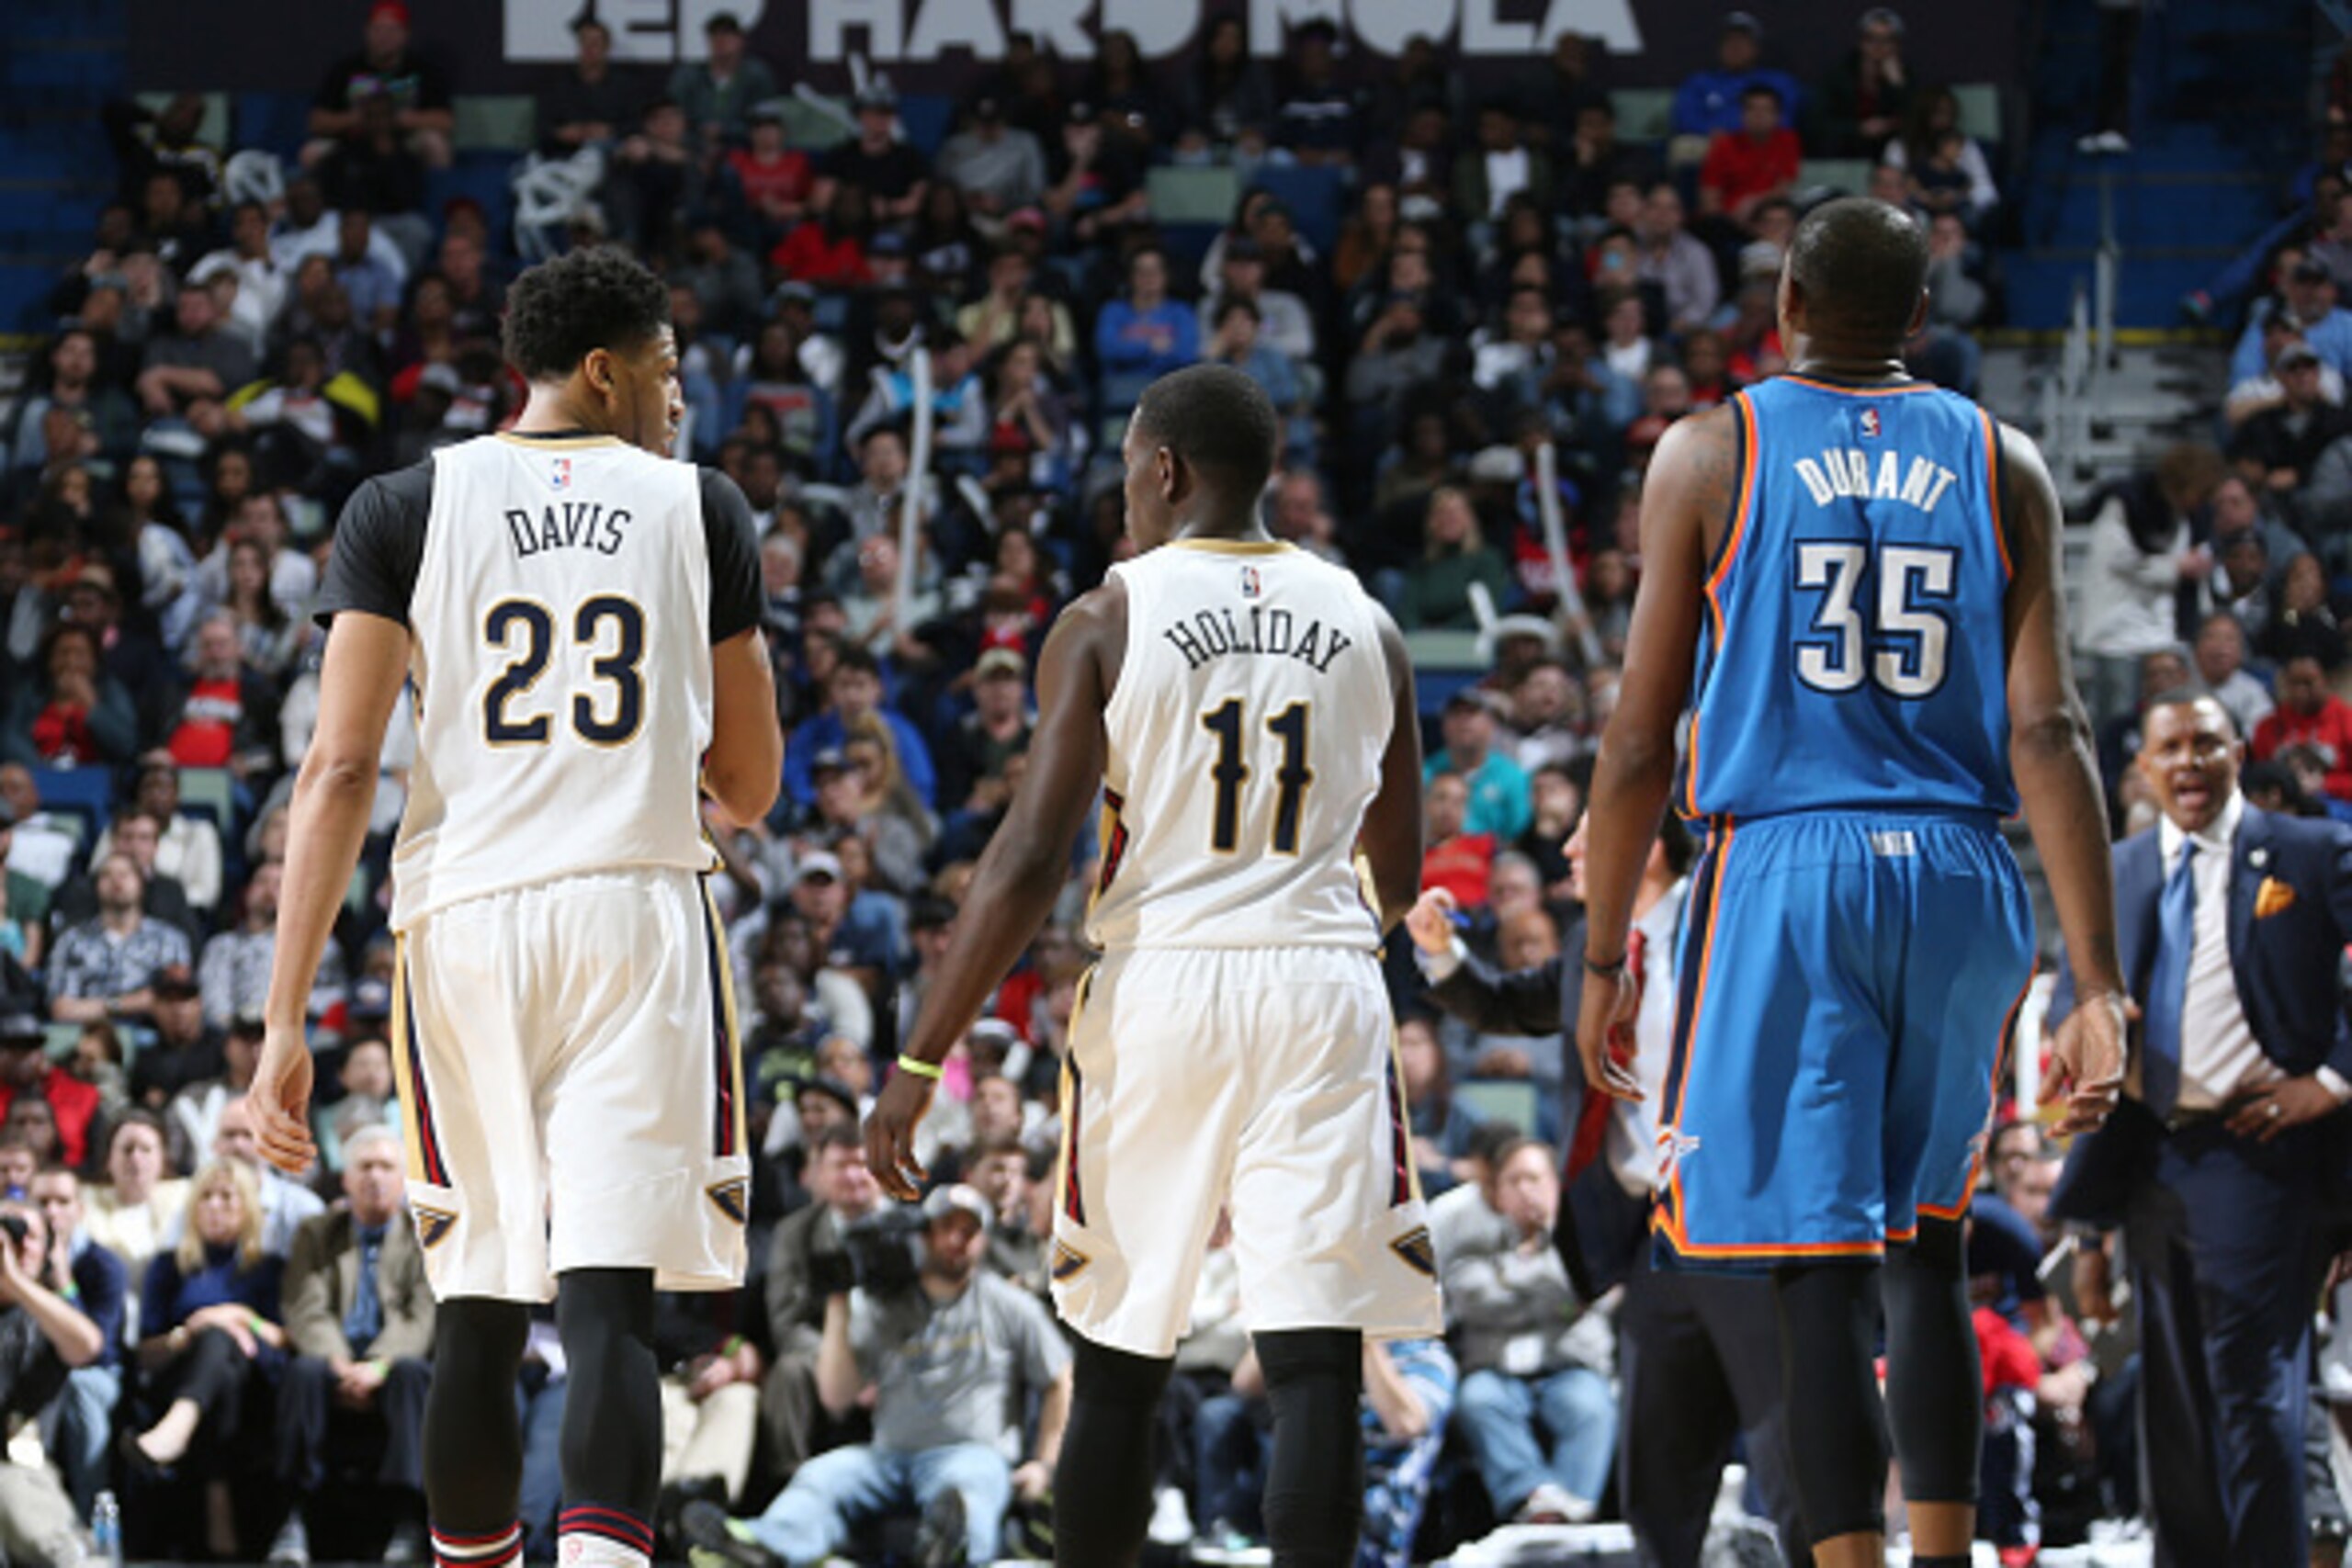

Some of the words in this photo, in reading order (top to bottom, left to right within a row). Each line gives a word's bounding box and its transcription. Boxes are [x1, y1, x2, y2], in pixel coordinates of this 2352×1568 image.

[504, 502, 632, 558] DAVIS
[1792, 447, 1958, 513] DURANT
[482, 593, 647, 750] 23
[1162, 605, 1352, 674] HOLIDAY
[1792, 537, 1962, 702] 35
[1200, 696, 1315, 857] 11
